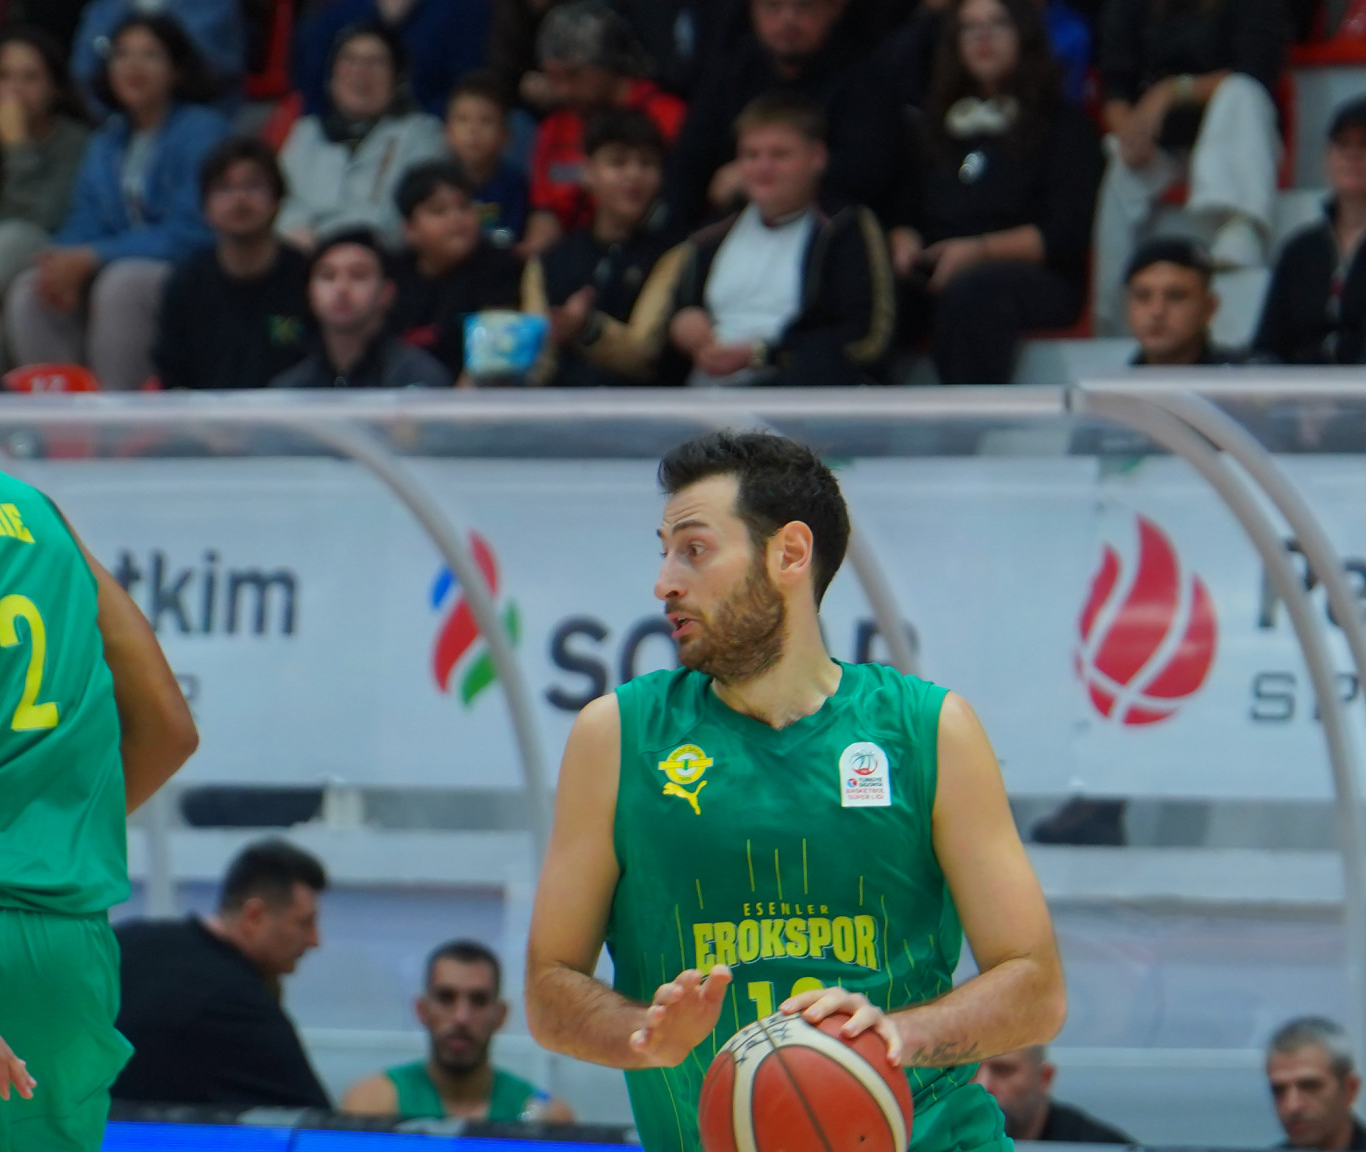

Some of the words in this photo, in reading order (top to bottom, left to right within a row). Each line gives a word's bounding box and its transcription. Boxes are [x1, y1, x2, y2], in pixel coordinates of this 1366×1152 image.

[115, 548, 297, 634] tkim
[743, 902, 829, 917] ESENLER
[693, 914, 881, 980] EROKSPOR
